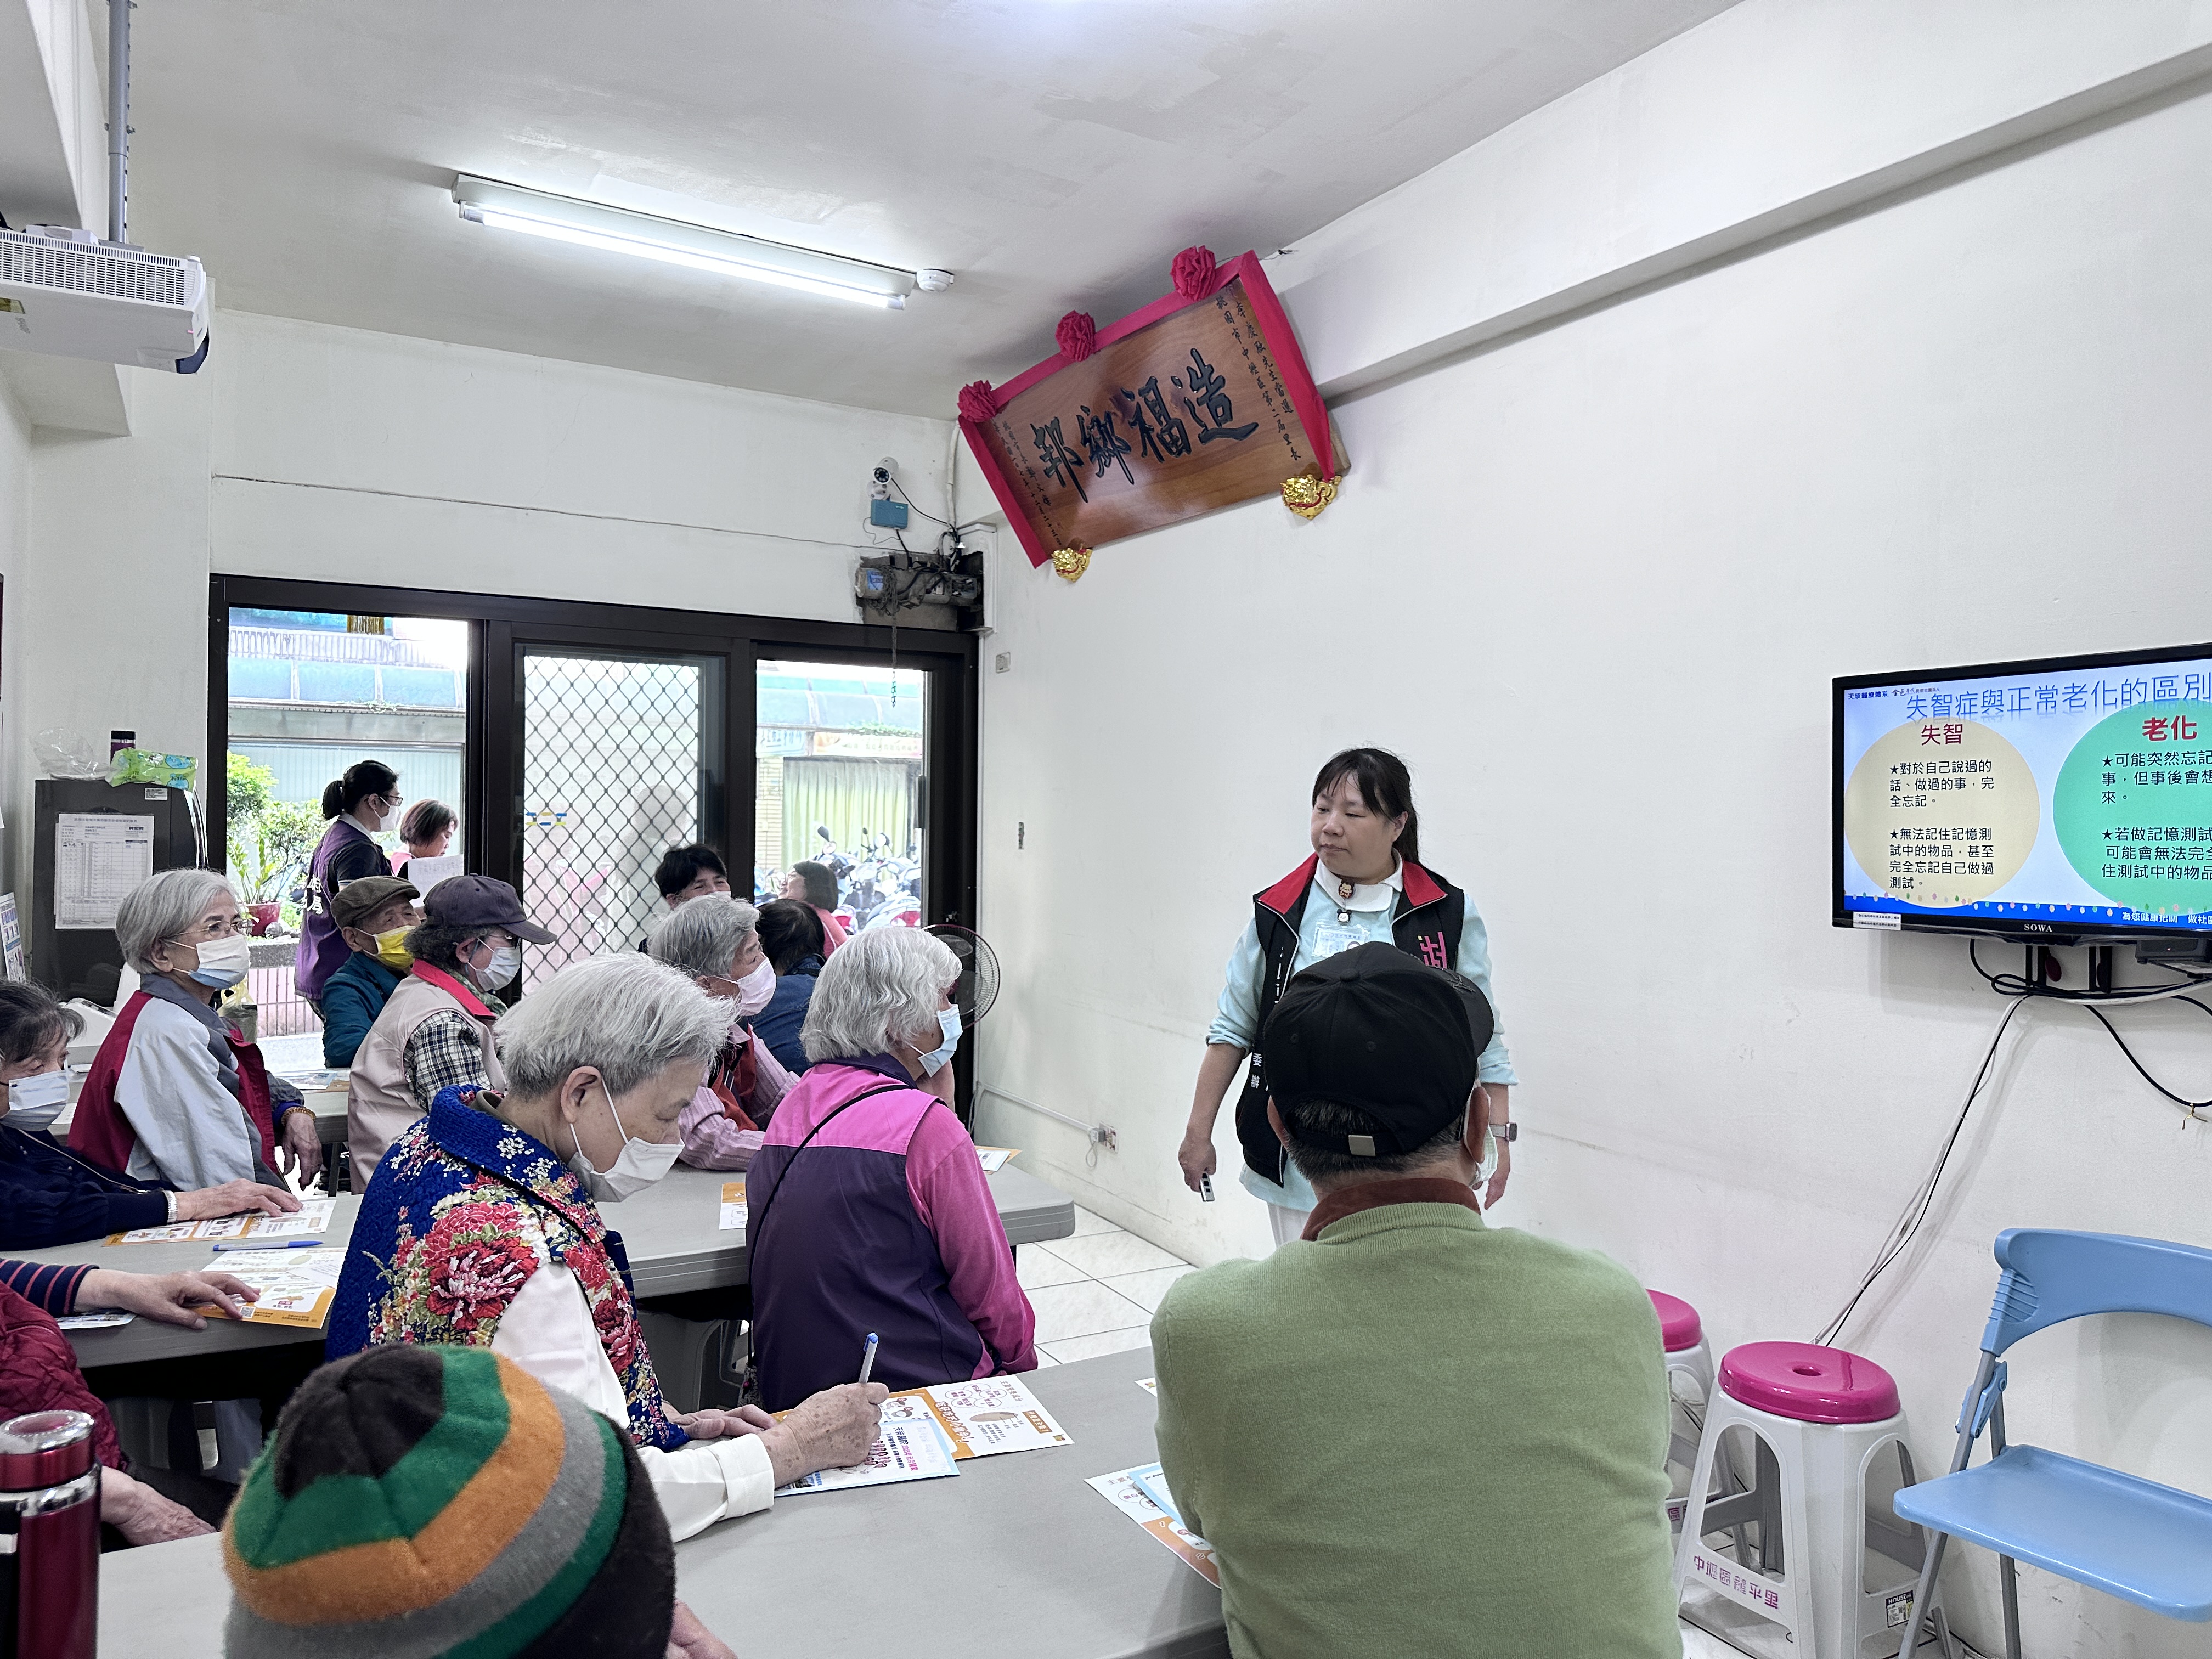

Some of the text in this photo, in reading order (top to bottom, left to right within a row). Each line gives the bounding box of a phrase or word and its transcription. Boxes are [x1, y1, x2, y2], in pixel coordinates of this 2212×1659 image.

[1029, 347, 1260, 504] 造福鄉邦
[1906, 672, 2212, 719] 失智症與正常老化的區別
[1921, 723, 1963, 746] 失智
[2142, 715, 2198, 742] 老化
[2101, 790, 2127, 805] 來。
[1889, 860, 1994, 876] 完全忘記自己做過
[2101, 864, 2212, 881] 住測試中的物品
[2024, 923, 2052, 933] SOWA
[1694, 1555, 1779, 1610] 中壢區龍平里
